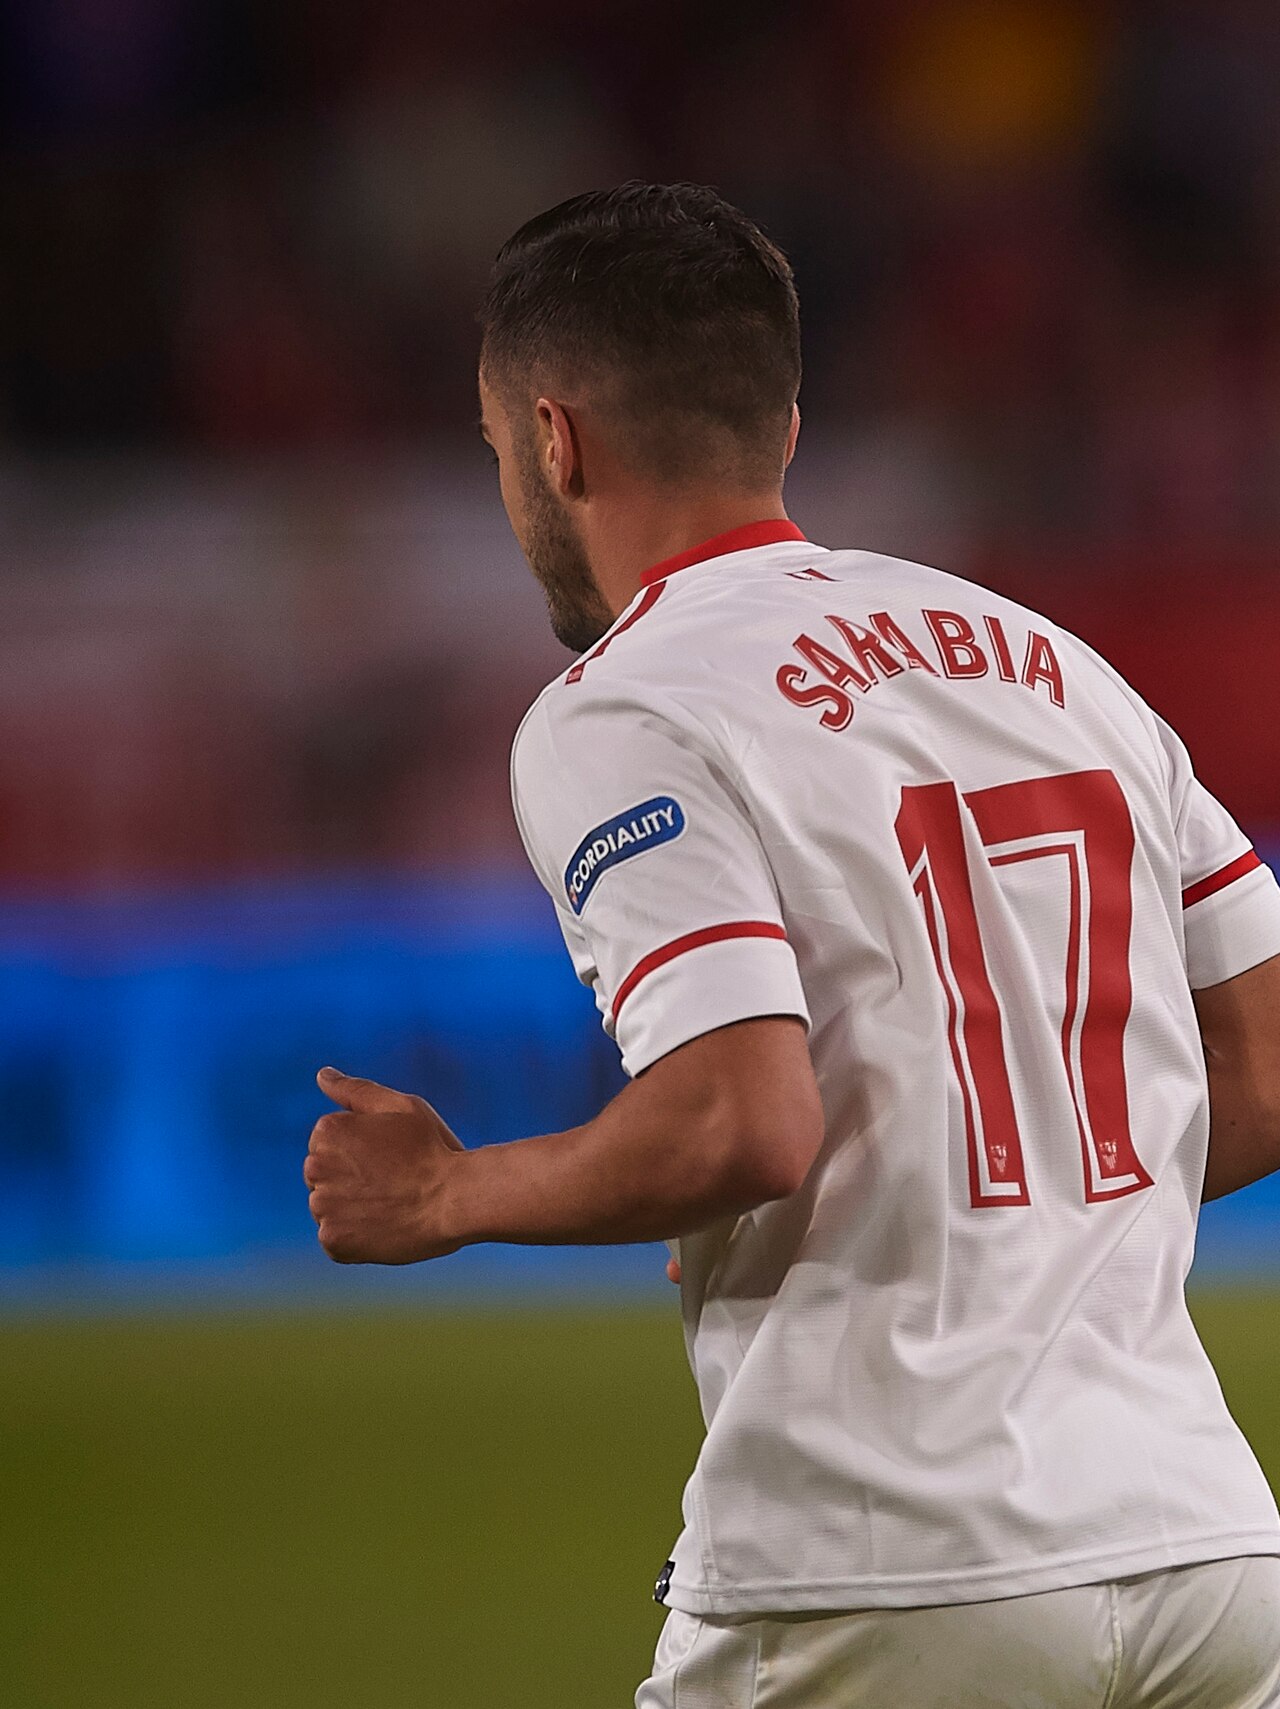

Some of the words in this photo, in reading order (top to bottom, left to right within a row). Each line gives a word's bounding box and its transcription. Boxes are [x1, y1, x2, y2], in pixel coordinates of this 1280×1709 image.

[776, 609, 1065, 732] SARABIA
[572, 805, 675, 893] CORDIALITY
[894, 769, 1156, 1209] 17
